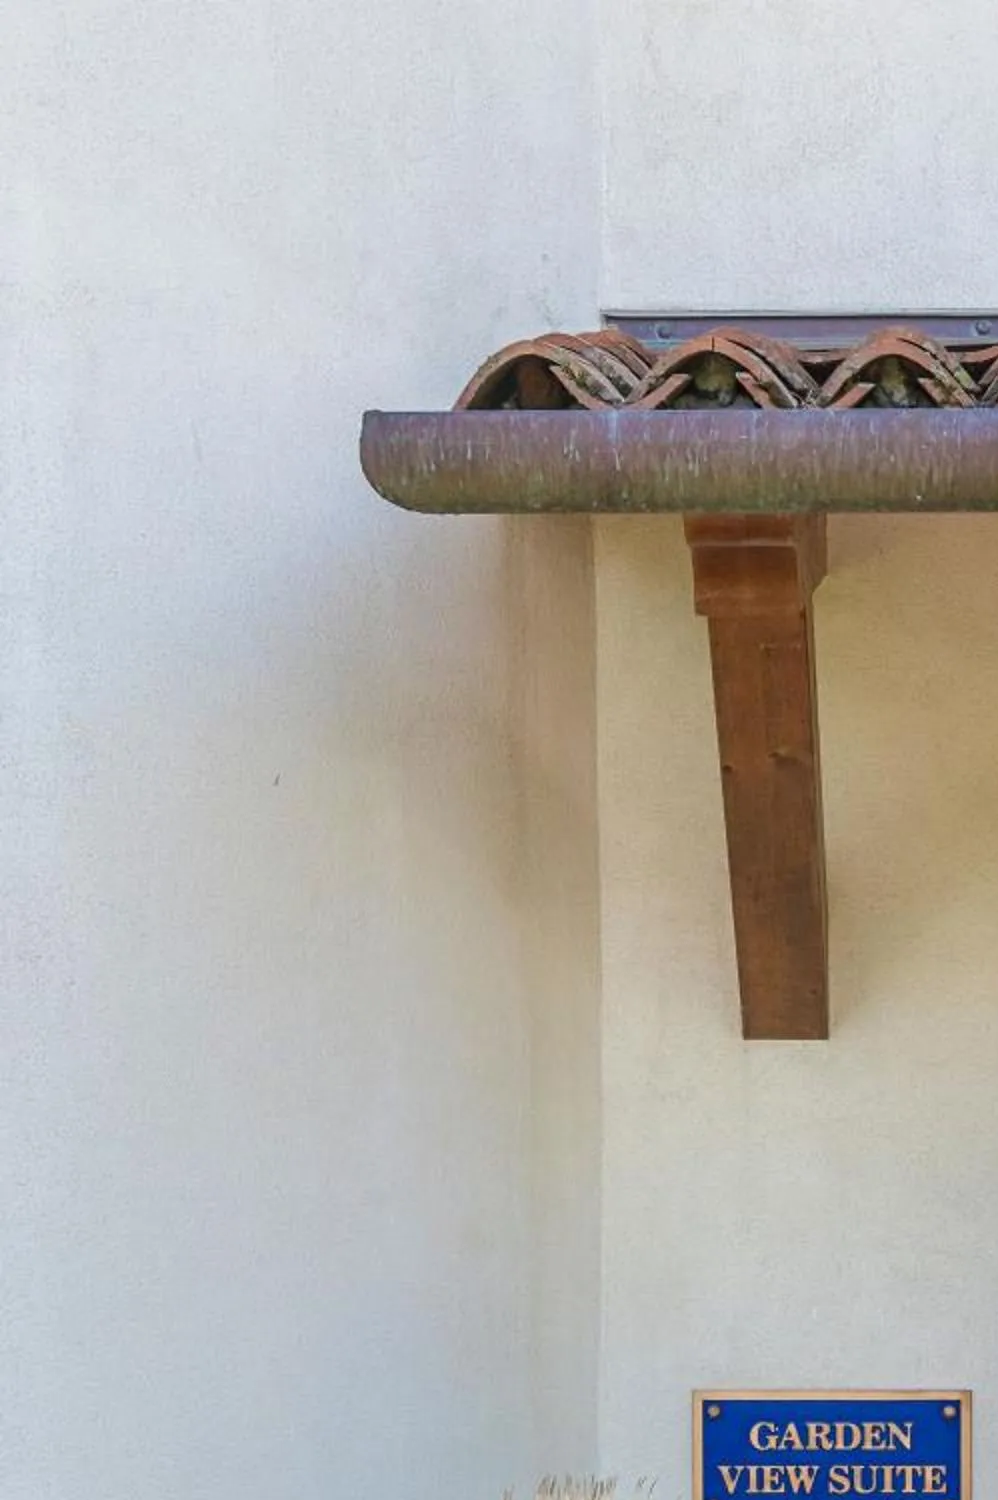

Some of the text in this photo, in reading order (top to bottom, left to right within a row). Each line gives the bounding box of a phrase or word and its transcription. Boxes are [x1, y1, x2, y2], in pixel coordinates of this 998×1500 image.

[749, 1421, 912, 1451] GARDEN
[718, 1465, 947, 1494] VIEW SUITE
